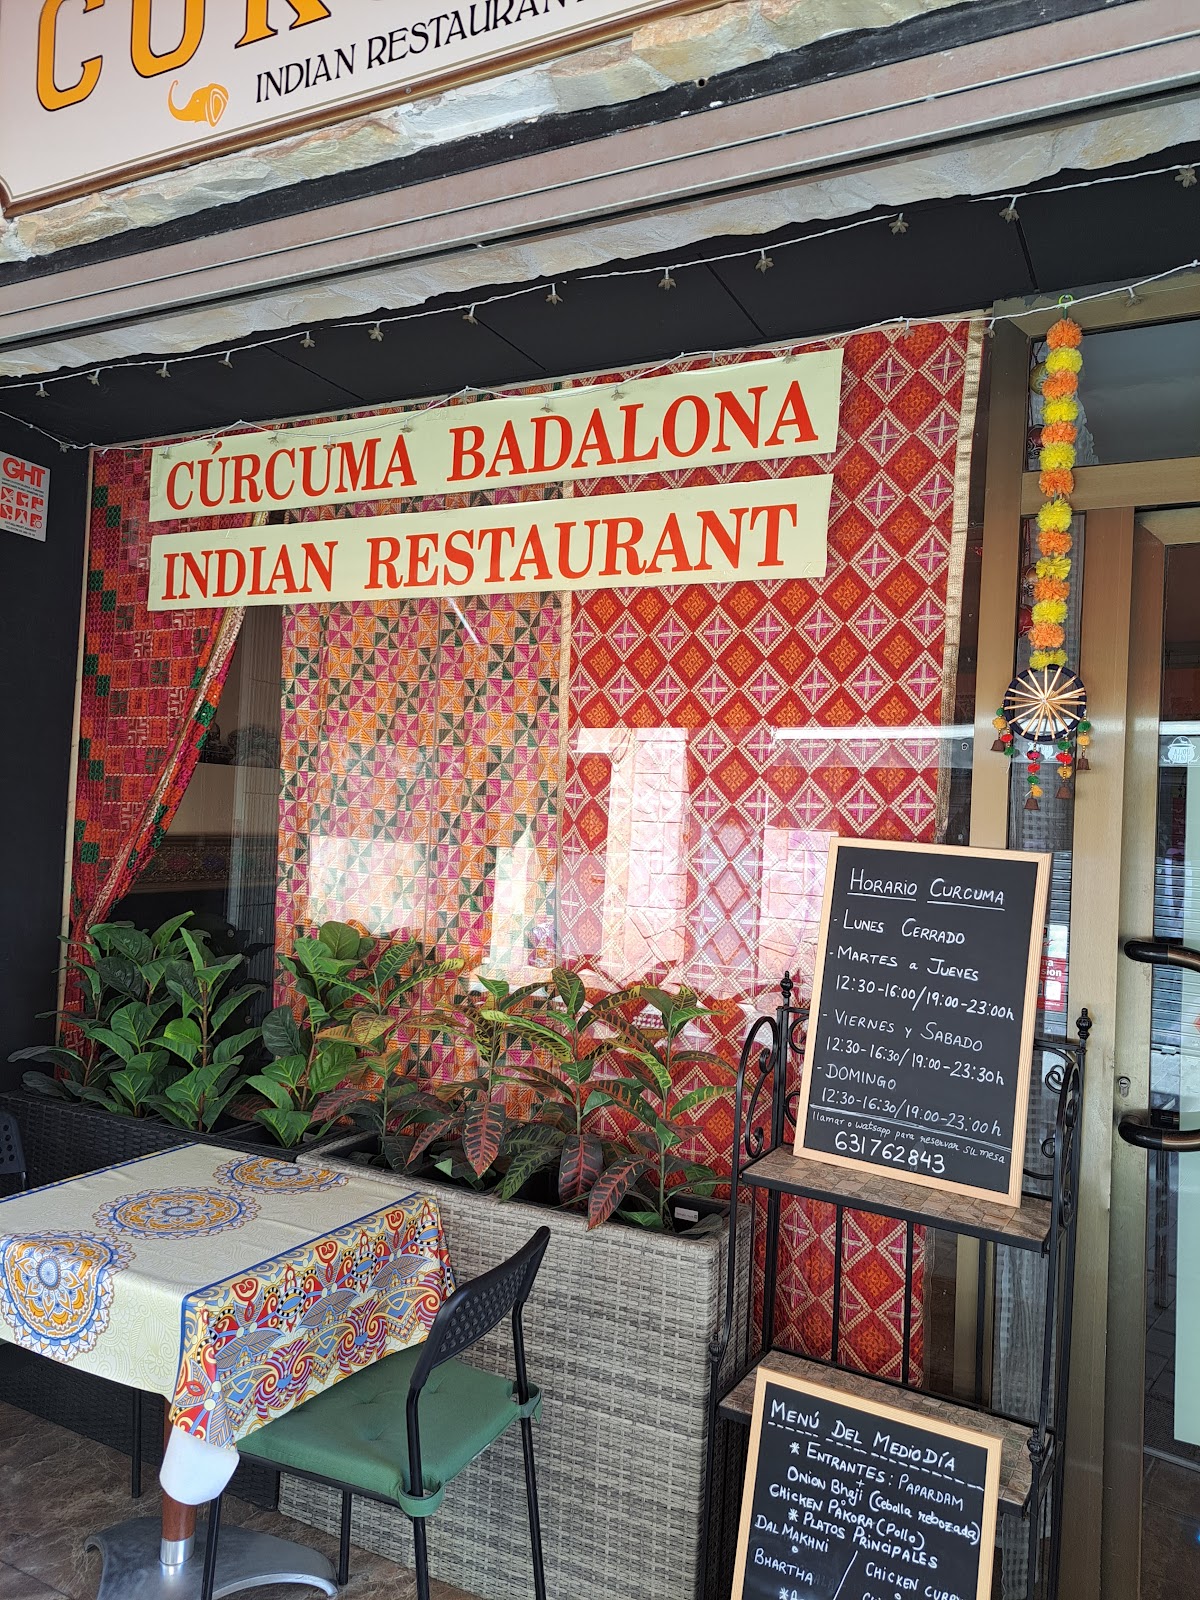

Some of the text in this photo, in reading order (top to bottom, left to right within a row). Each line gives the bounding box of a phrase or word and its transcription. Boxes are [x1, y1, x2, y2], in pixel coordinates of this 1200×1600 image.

[255, 44, 357, 103] INDIAN
[165, 380, 819, 511] CÚRCUMA BADALONA
[2, 457, 46, 488] GHT
[161, 503, 798, 600] INDIAN RESTAURANT
[929, 877, 1005, 906] CURCUMA
[843, 908, 966, 945] LUNES CERRADO
[837, 945, 899, 968] MARTES
[926, 957, 979, 982] JUEVES
[834, 1008, 895, 1034] VIERNES
[920, 1021, 983, 1052] SABADO
[825, 1063, 897, 1090] DOMINGO
[812, 1110, 845, 1125] llamar
[855, 1121, 891, 1138] watsapp
[894, 1130, 915, 1141] para
[919, 1135, 960, 1151] reservar
[979, 1149, 1006, 1164] mesa
[834, 1130, 946, 1174] 631762843
[770, 1399, 820, 1429] MENÚ
[831, 1419, 863, 1444] DEL
[898, 1473, 964, 1512] PAPARDAM
[754, 1514, 780, 1535] DAL
[803, 1511, 846, 1540] PLATOS
[828, 1498, 873, 1529] PAKORA
[754, 1547, 813, 1586] BHARTHA
